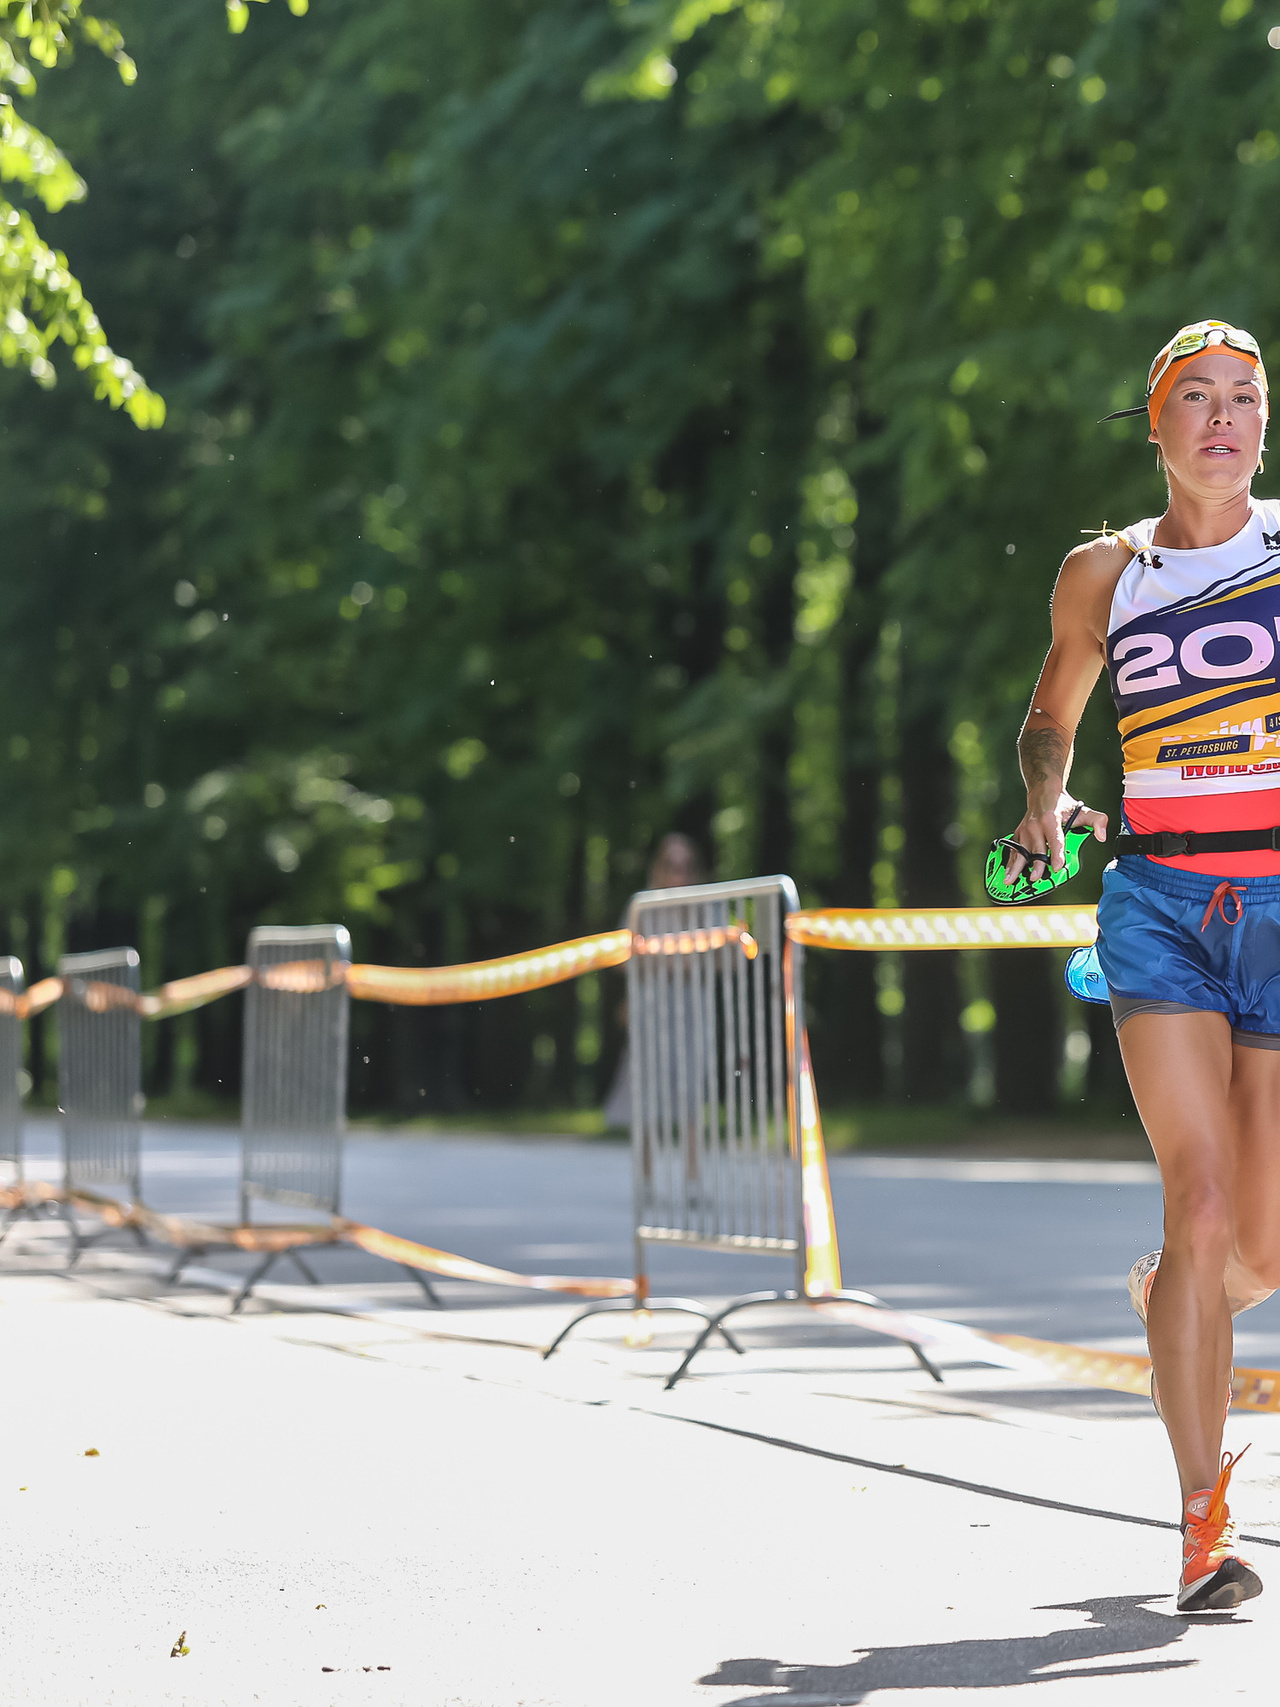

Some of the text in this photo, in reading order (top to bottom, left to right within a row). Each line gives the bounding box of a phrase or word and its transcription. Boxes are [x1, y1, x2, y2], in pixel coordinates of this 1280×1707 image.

[1269, 718, 1275, 728] 4
[1164, 739, 1239, 758] ST. PETERSBURG
